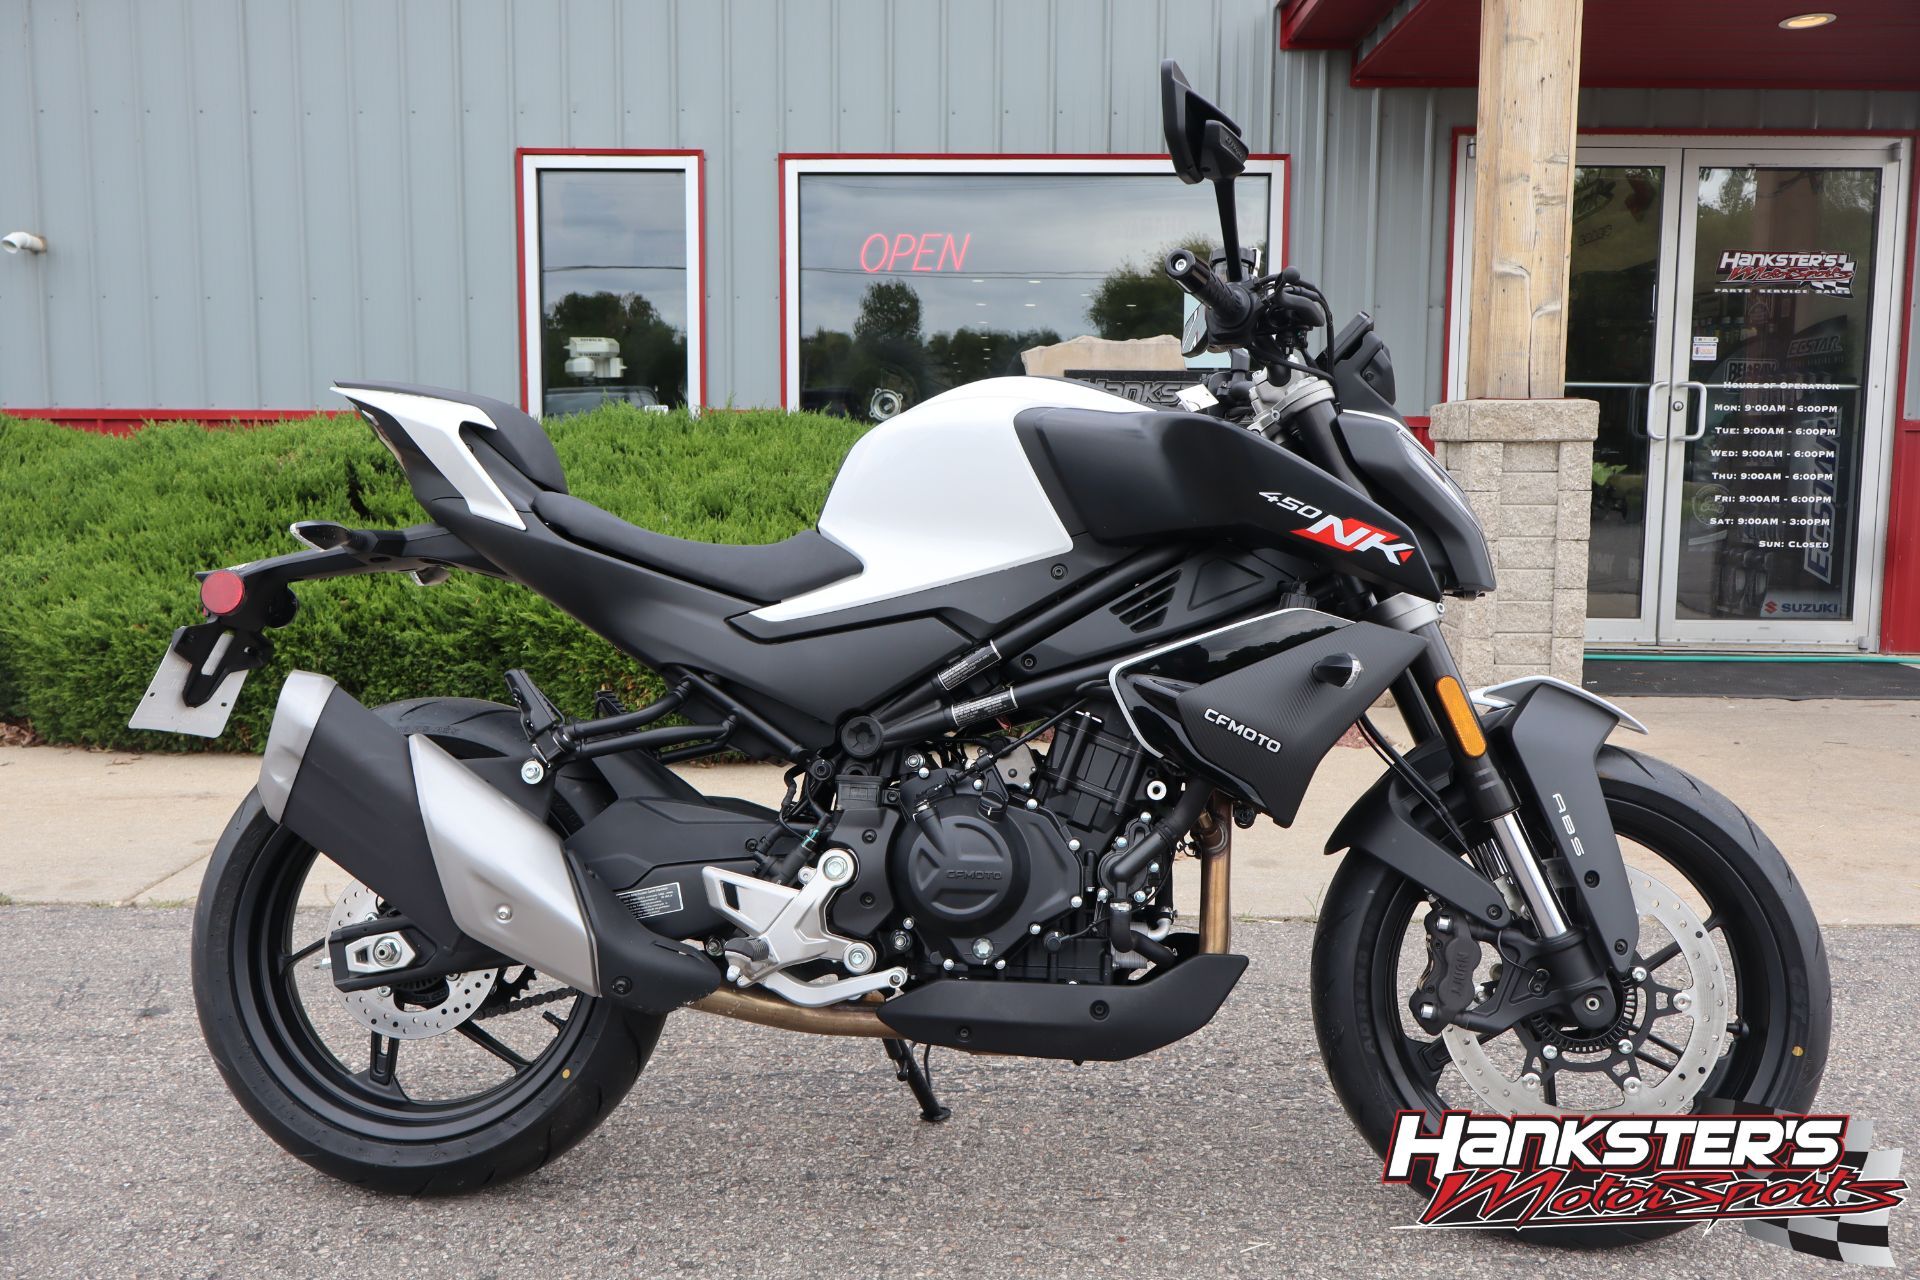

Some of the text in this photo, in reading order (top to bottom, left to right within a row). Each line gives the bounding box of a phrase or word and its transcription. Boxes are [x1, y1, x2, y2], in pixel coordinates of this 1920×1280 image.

[861, 233, 971, 272] OPEN
[1744, 404, 1786, 412] 9:00AM
[1797, 405, 1838, 413] 6:00PM
[1743, 427, 1784, 435] 9:00AM
[1794, 450, 1835, 458] 6:00PM
[1739, 495, 1780, 503] 9:00AM
[1789, 518, 1830, 526] 3:00PM
[1258, 491, 1415, 566] 450 NK
[1781, 602, 1838, 613] SUZUKI
[1204, 708, 1281, 753] CFMOTO
[1552, 793, 1585, 857] ABS
[945, 870, 1002, 880] CFMOTO
